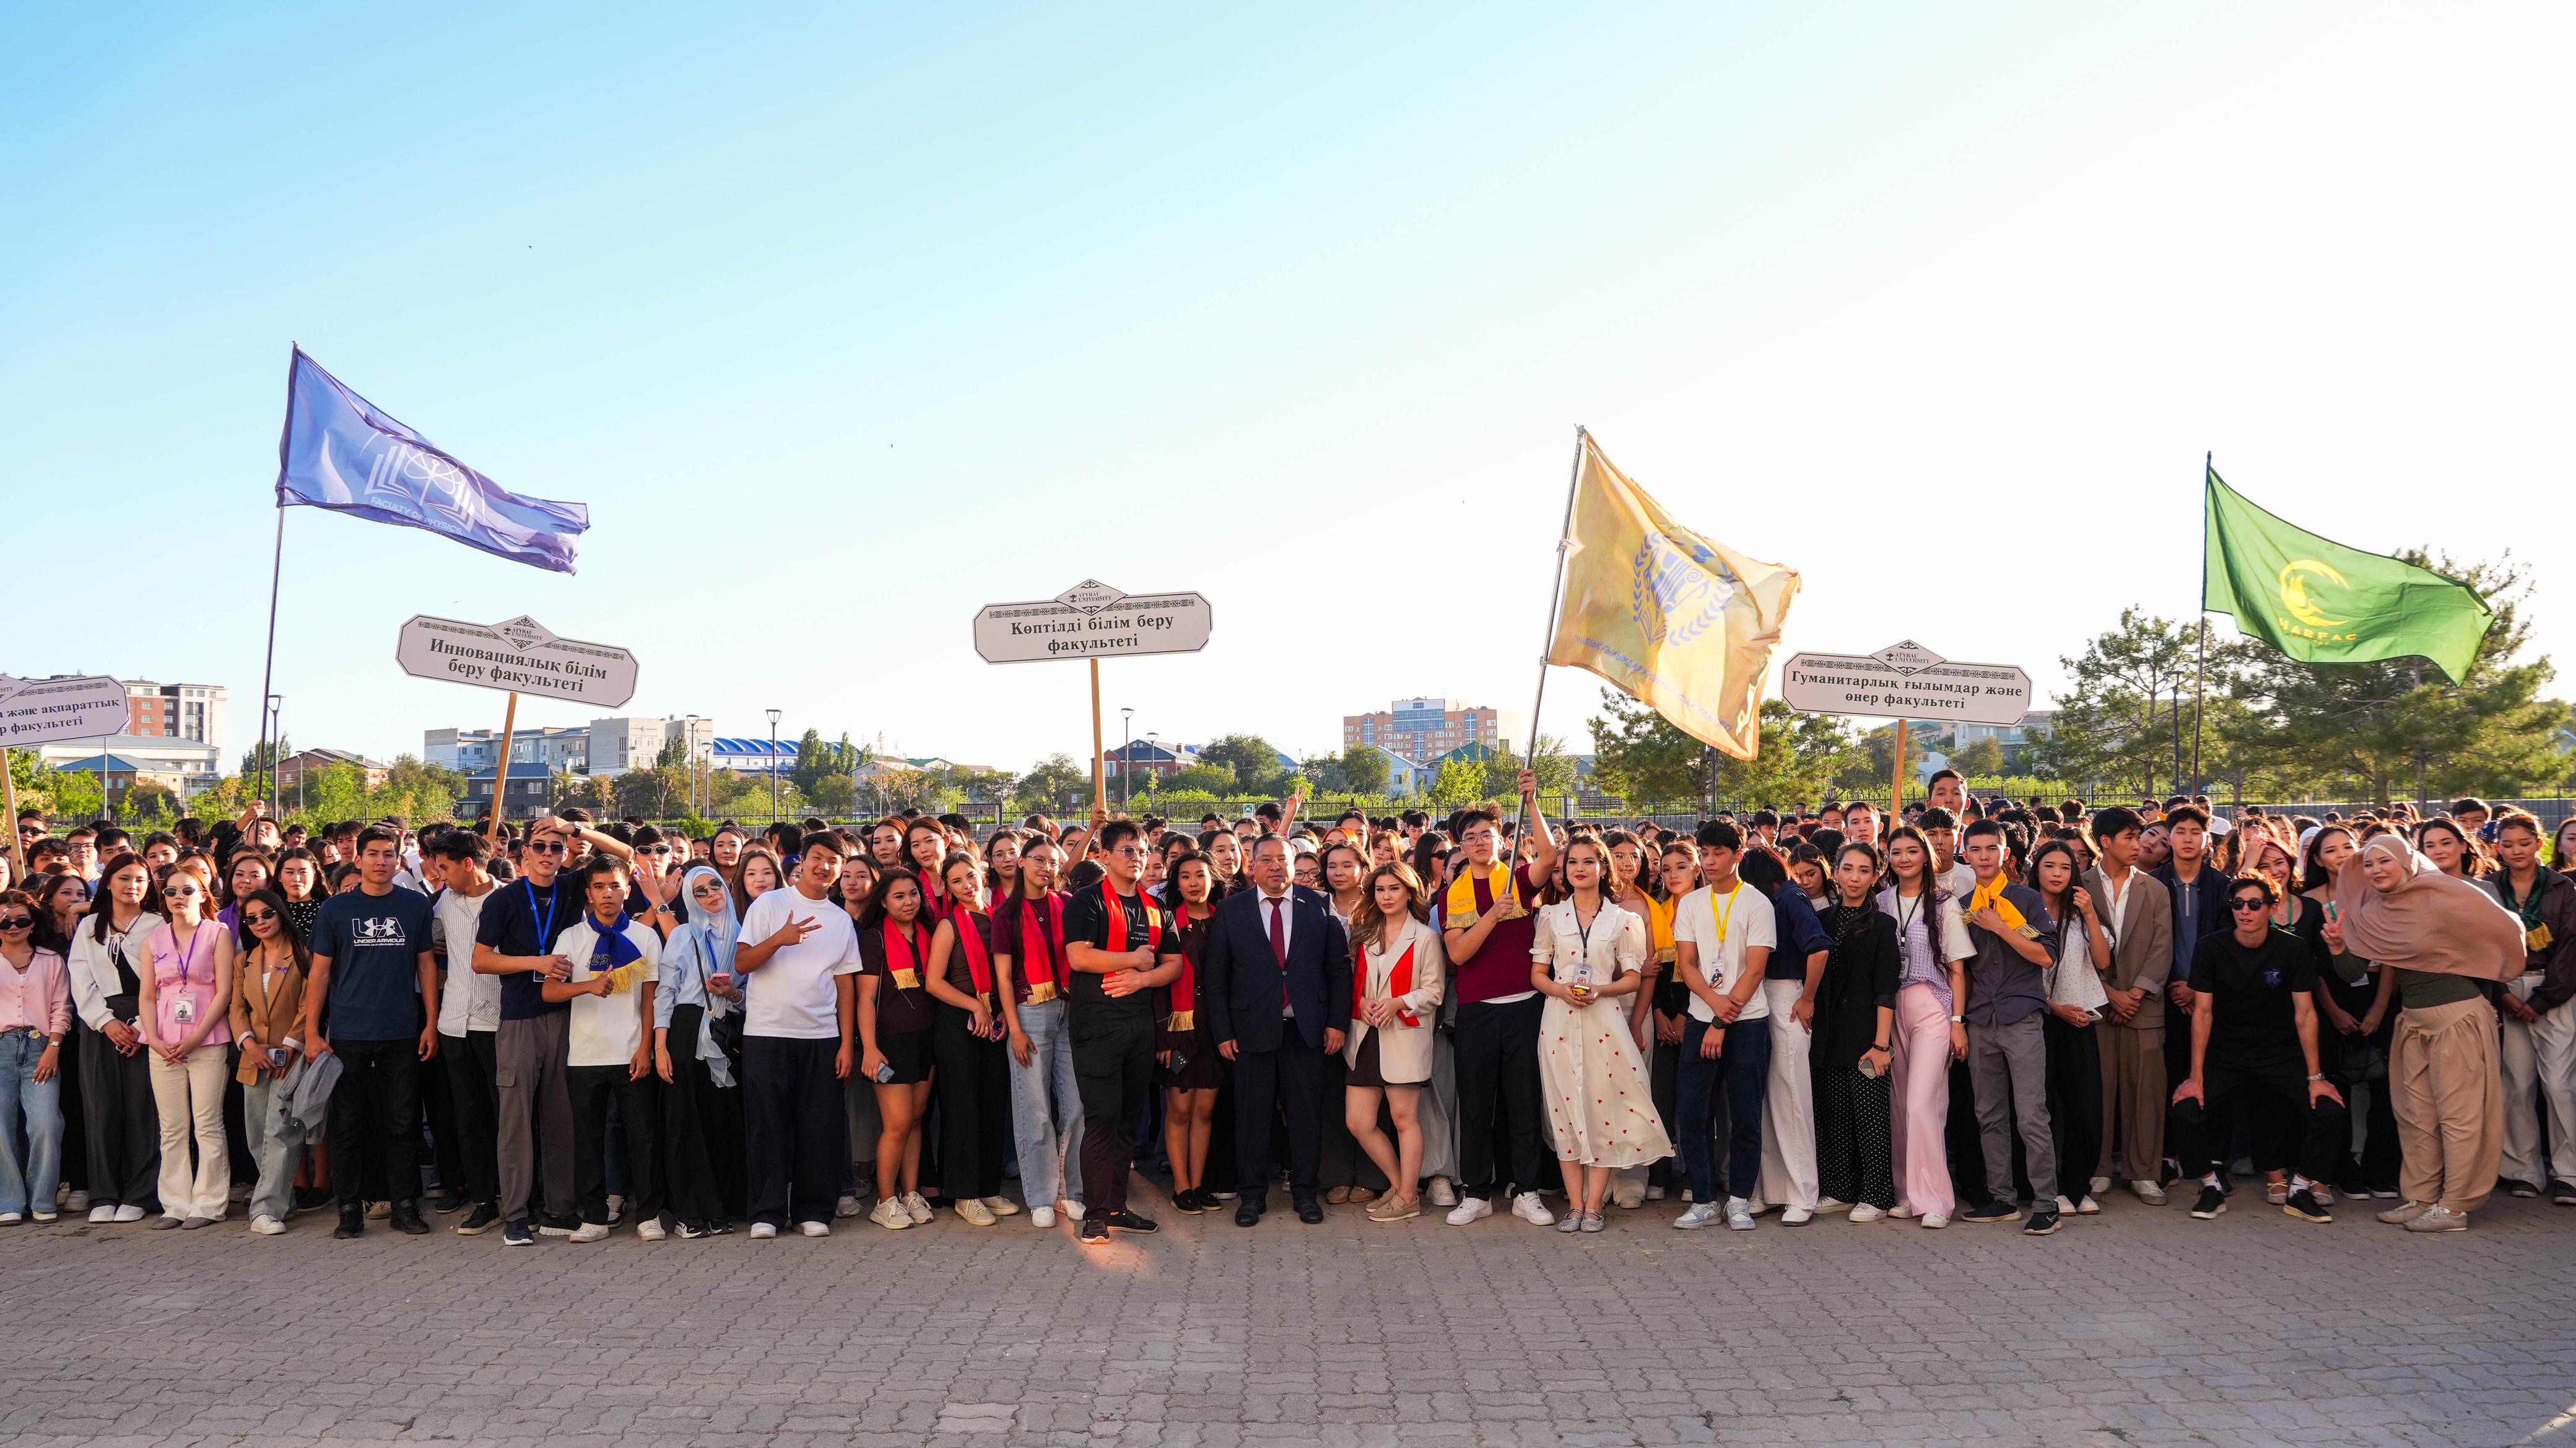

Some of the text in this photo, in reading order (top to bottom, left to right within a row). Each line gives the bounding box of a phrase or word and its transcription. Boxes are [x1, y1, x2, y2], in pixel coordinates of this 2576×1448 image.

[371, 497, 411, 514] FACULTY
[412, 511, 424, 521] OF
[1011, 614, 1174, 635] Көптілді білім беру
[512, 632, 542, 640] UNIVERSITY
[1048, 633, 1138, 654] факультеті
[430, 638, 607, 679] Инновациялық білім
[449, 659, 583, 692] беру факультеті
[1791, 671, 2022, 697] Гуманитарлық ғылымдар және
[7, 707, 37, 717] және
[41, 699, 120, 714] ақпараттық
[1845, 693, 1965, 709] өнер факультеті
[11, 716, 82, 734] факультеті
